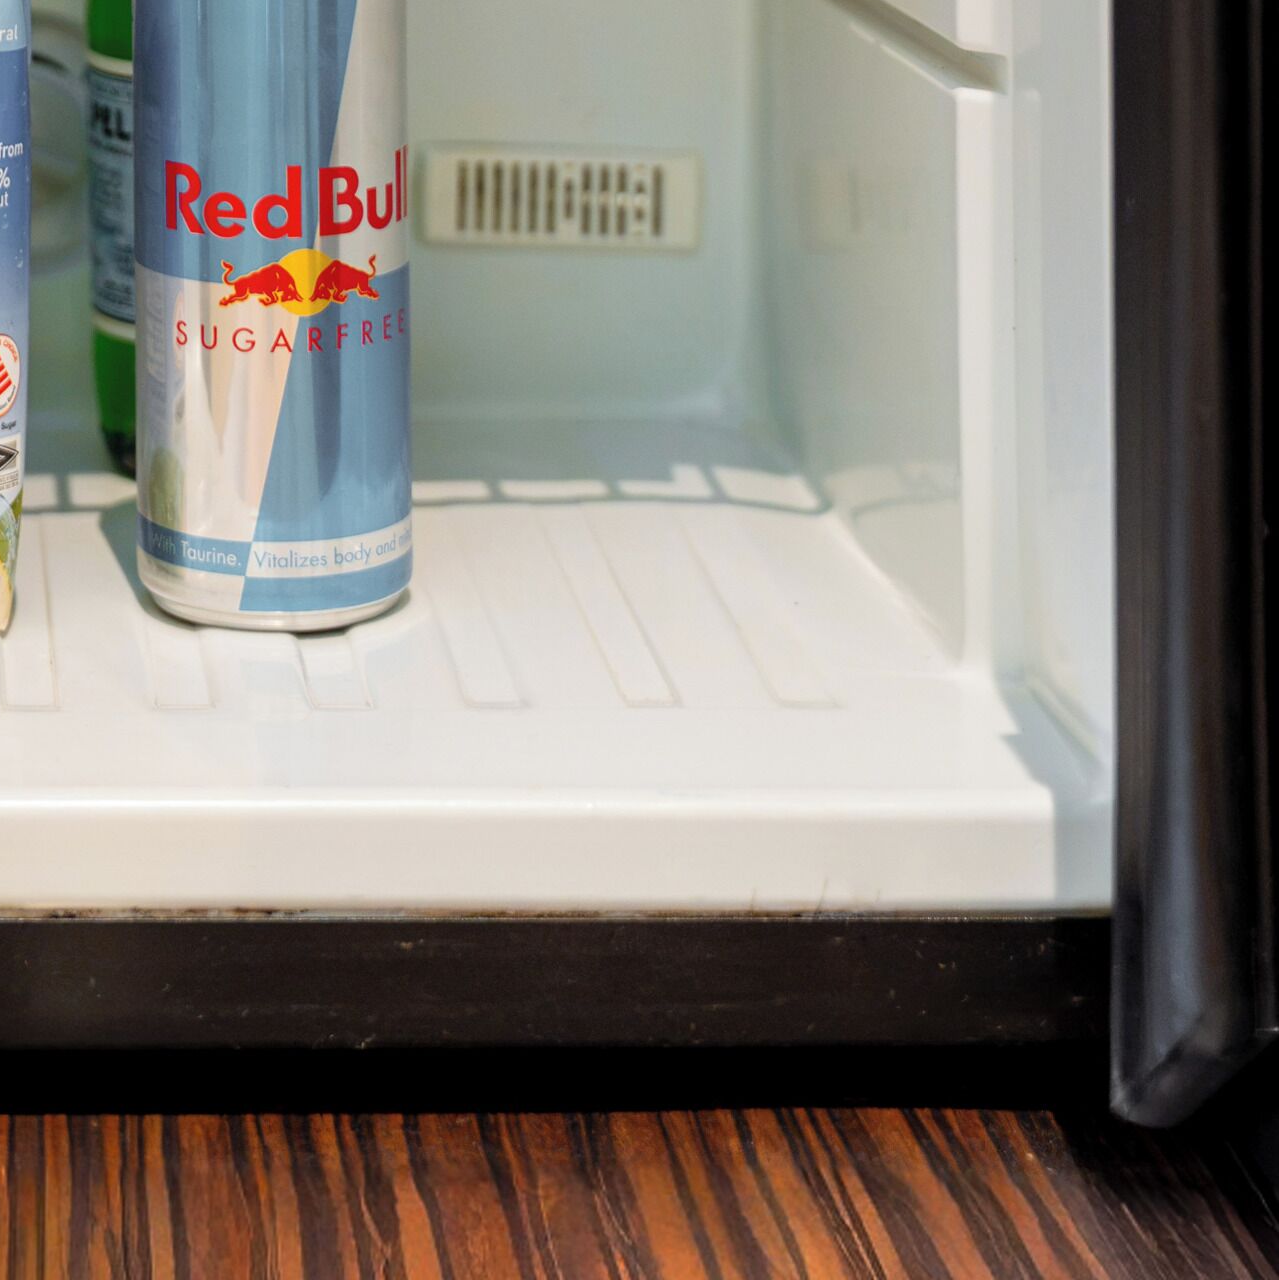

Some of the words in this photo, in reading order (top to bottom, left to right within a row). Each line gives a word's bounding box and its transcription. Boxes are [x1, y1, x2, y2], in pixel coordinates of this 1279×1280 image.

[164, 159, 303, 240] Red
[318, 143, 409, 238] Bull
[175, 307, 407, 354] SUGARFREE
[1, 419, 17, 432] Sugar
[180, 539, 242, 567] Taurine.
[253, 550, 328, 569] Vitalizes
[333, 544, 372, 566] body
[375, 532, 397, 557] and
